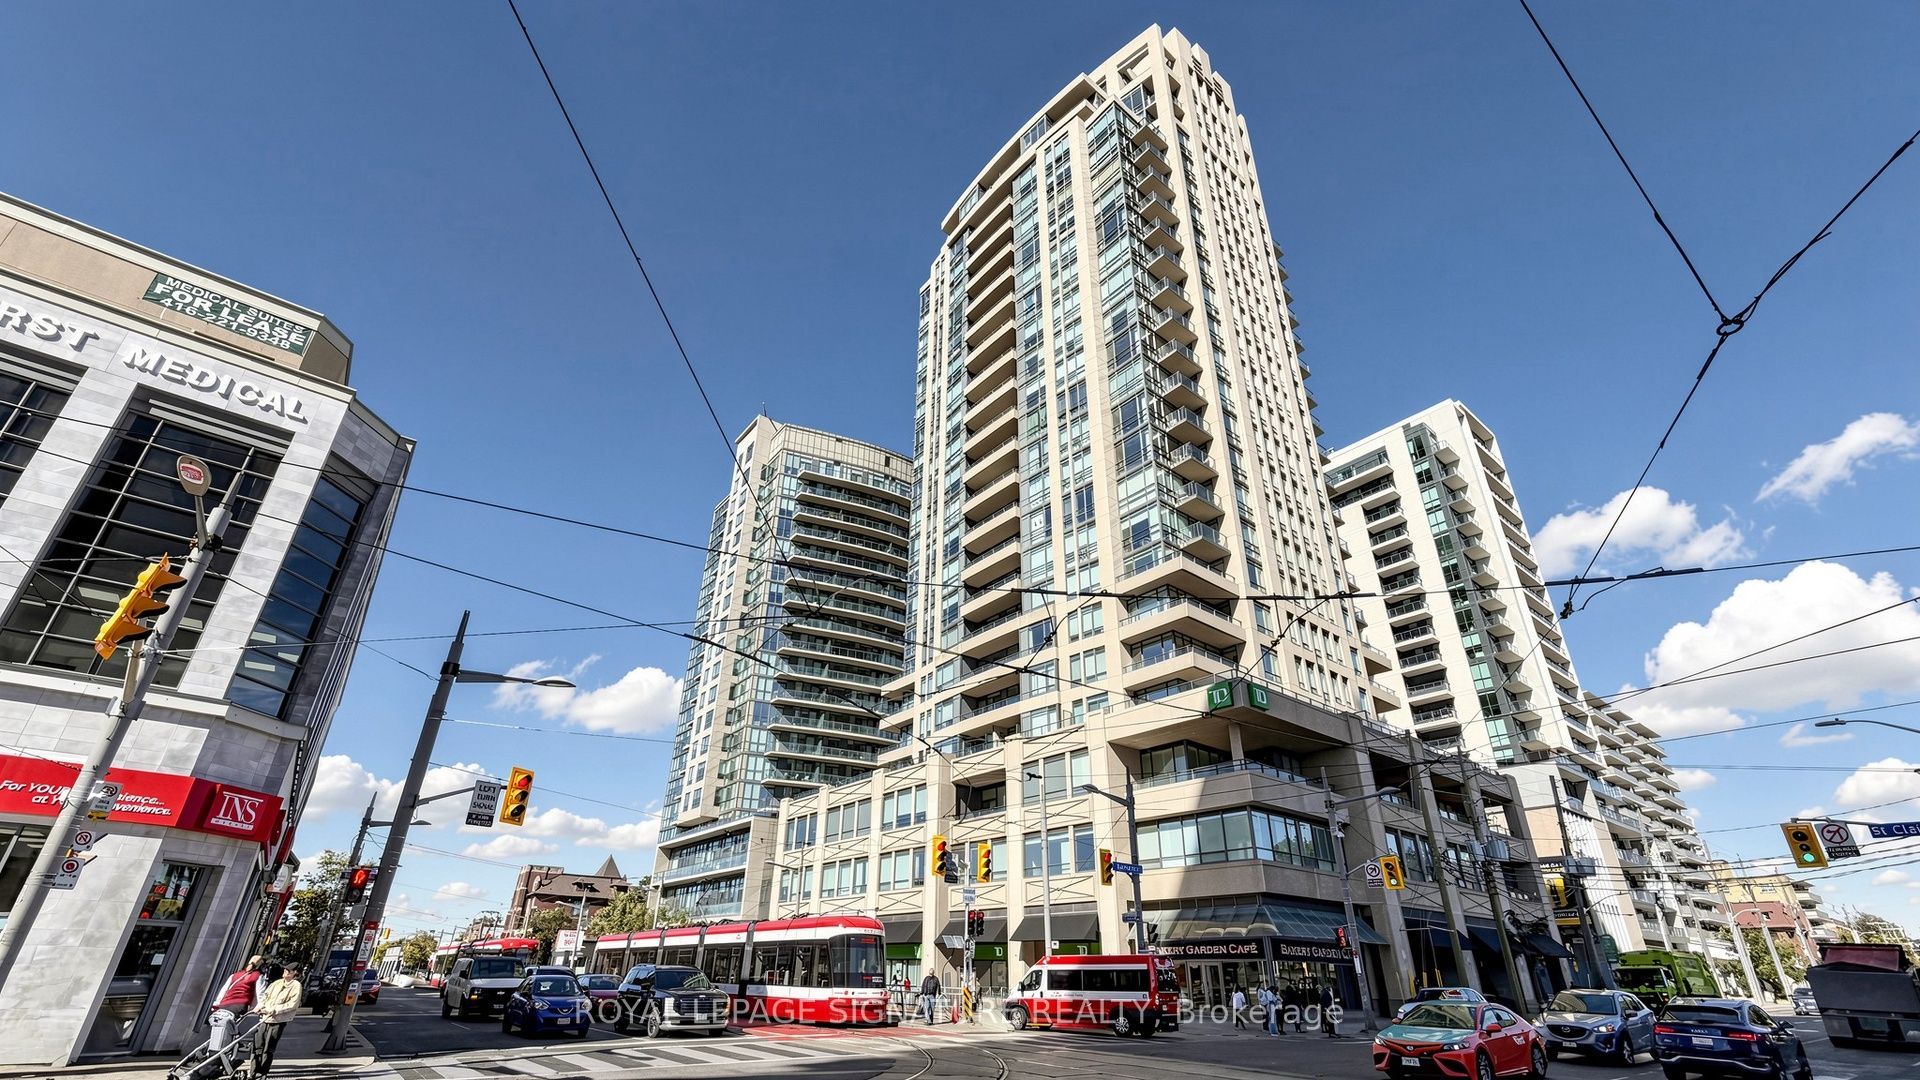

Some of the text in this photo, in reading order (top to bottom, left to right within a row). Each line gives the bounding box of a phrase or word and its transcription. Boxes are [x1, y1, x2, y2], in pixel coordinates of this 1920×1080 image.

[153, 282, 306, 346] FOR LEASE
[166, 277, 308, 334] MEDICAL SUITES
[160, 298, 291, 350] 416-221-9348
[122, 344, 308, 424] MEDICAL
[1209, 688, 1228, 704] TD
[0, 779, 27, 792] For
[32, 795, 49, 804] at
[216, 794, 259, 824] INS
[1871, 826, 1887, 835] St
[1185, 944, 1227, 955] GARDEN
